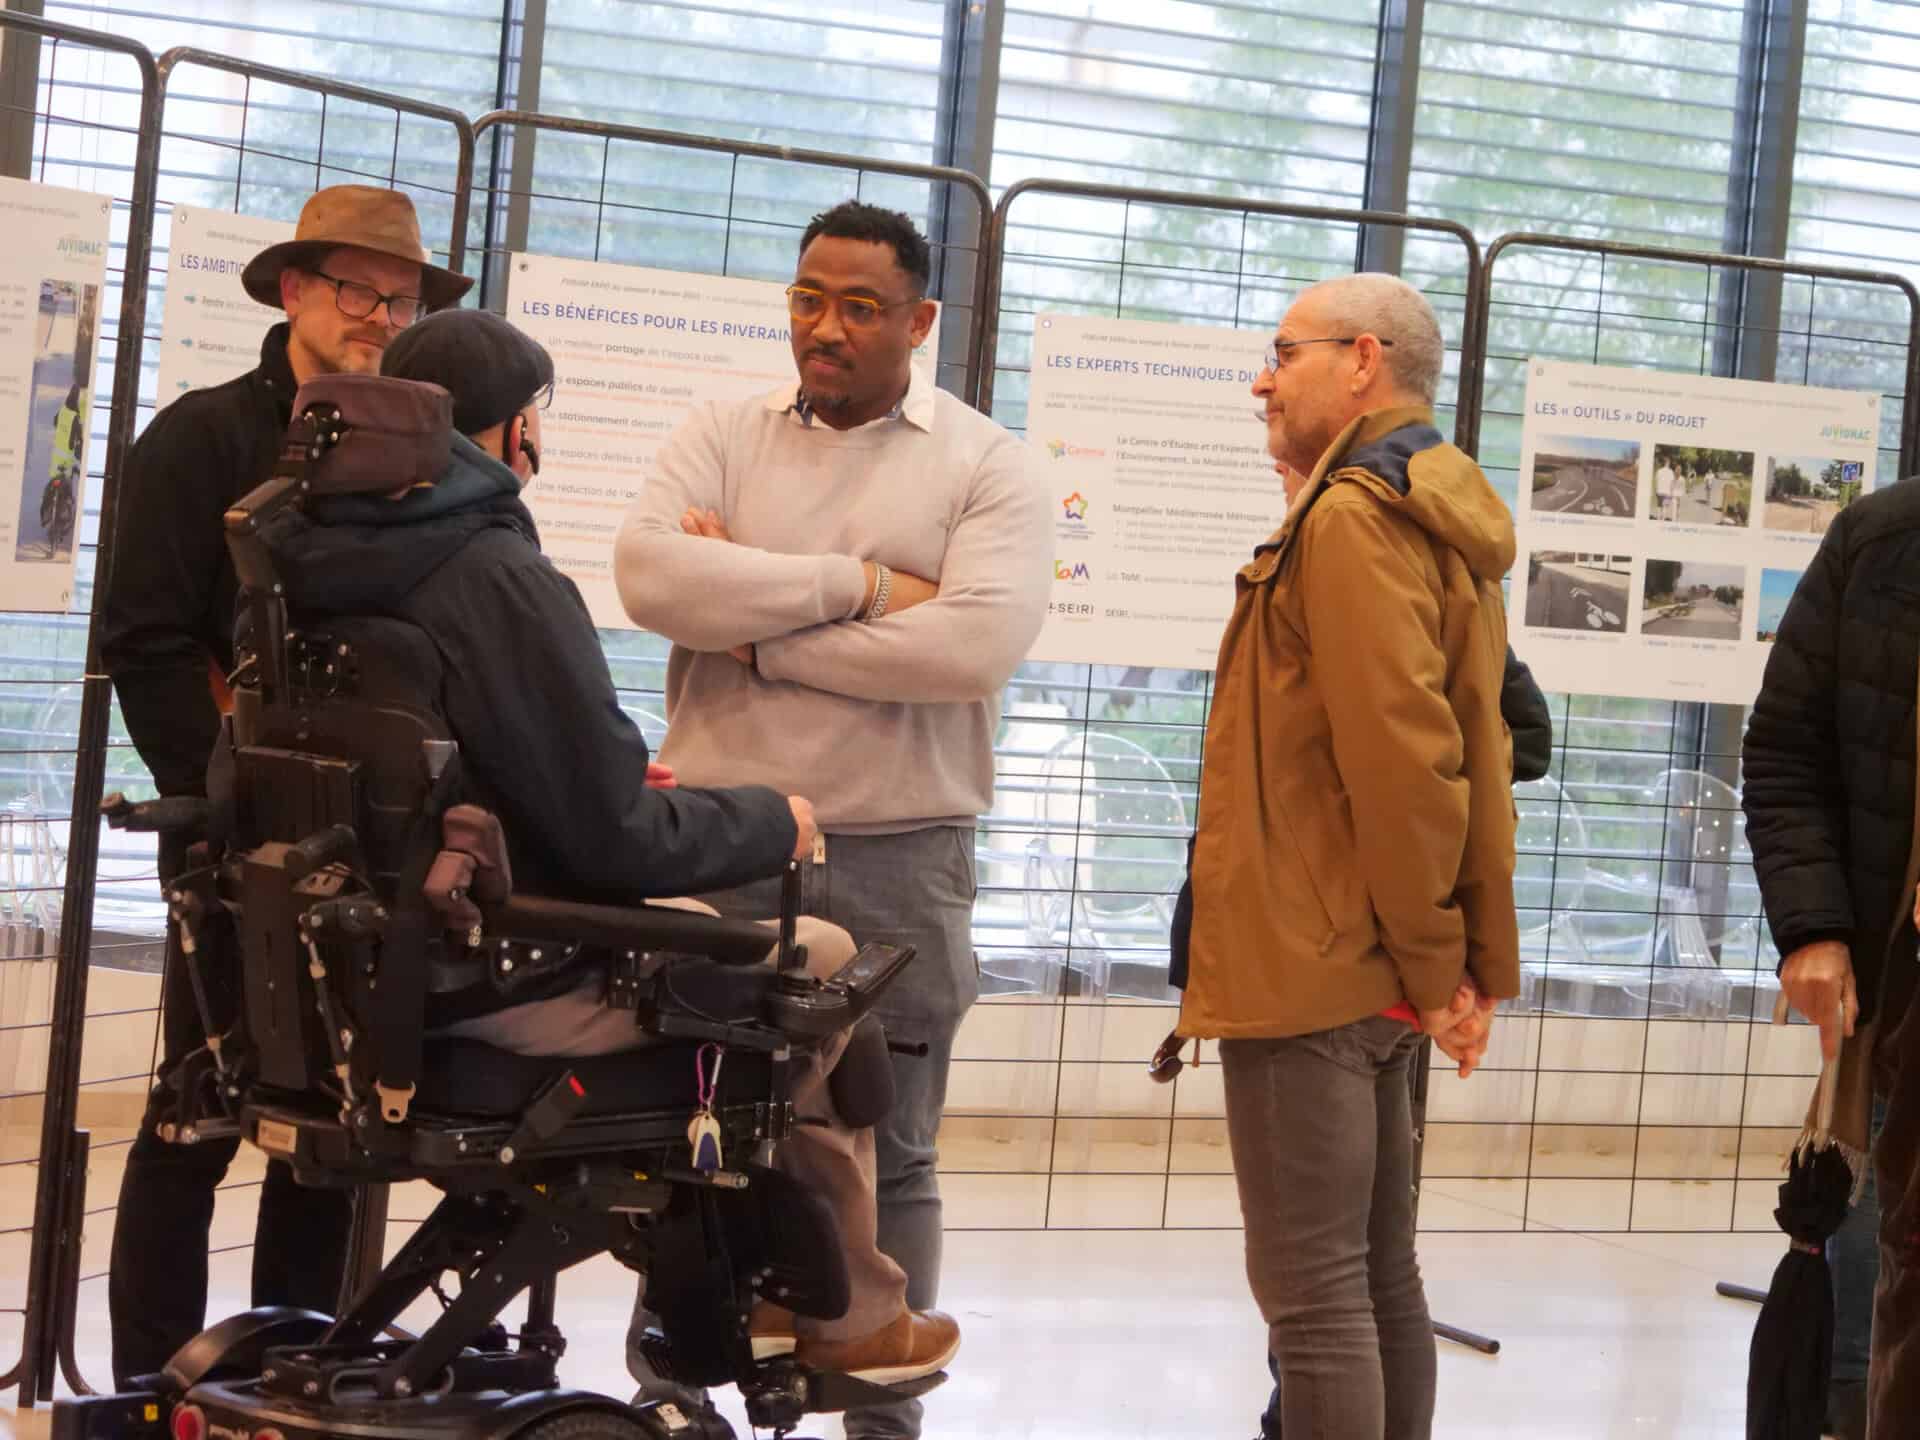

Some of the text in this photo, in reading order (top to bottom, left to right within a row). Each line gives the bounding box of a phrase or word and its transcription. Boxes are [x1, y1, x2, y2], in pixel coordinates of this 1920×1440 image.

[181, 254, 199, 270] LES
[523, 301, 549, 316] LES
[555, 302, 639, 326] BÉNÉFICES
[643, 313, 687, 332] POUR
[691, 319, 718, 334] LES
[606, 343, 645, 356] partage
[1047, 355, 1072, 368] LES
[1077, 357, 1140, 375] EXPERTS
[1144, 363, 1234, 383] TECHNIQUES
[566, 376, 606, 389] espaces
[558, 412, 629, 427] stationnement
[1535, 402, 1557, 415] LES
[1573, 405, 1620, 421] OUTILS
[1636, 411, 1654, 424] DU
[1658, 413, 1708, 429] PROJET
[1058, 602, 1095, 616] SEIRI
